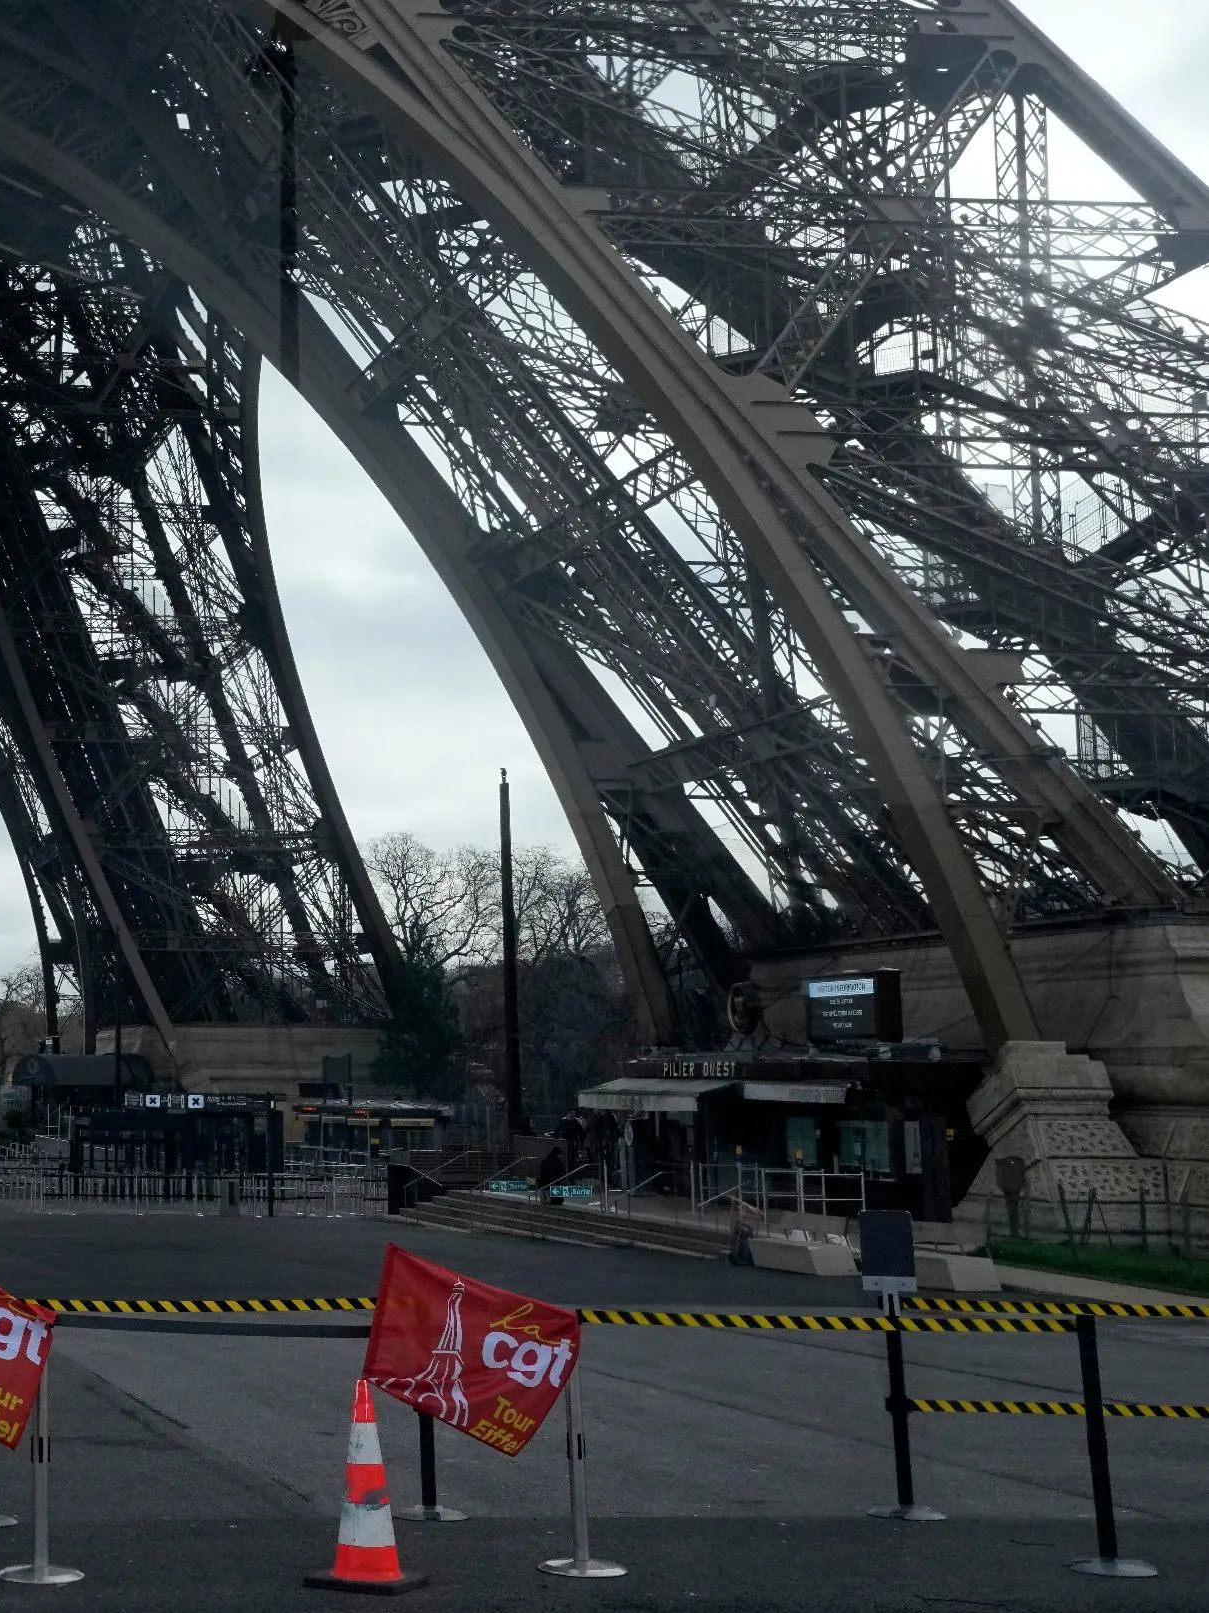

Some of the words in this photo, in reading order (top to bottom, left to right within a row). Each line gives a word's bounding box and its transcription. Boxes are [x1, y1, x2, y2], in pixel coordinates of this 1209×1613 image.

[663, 1062, 695, 1077] PILIER
[703, 1061, 736, 1078] OUEST
[482, 1331, 573, 1388] cgt
[493, 1395, 536, 1432] Tour
